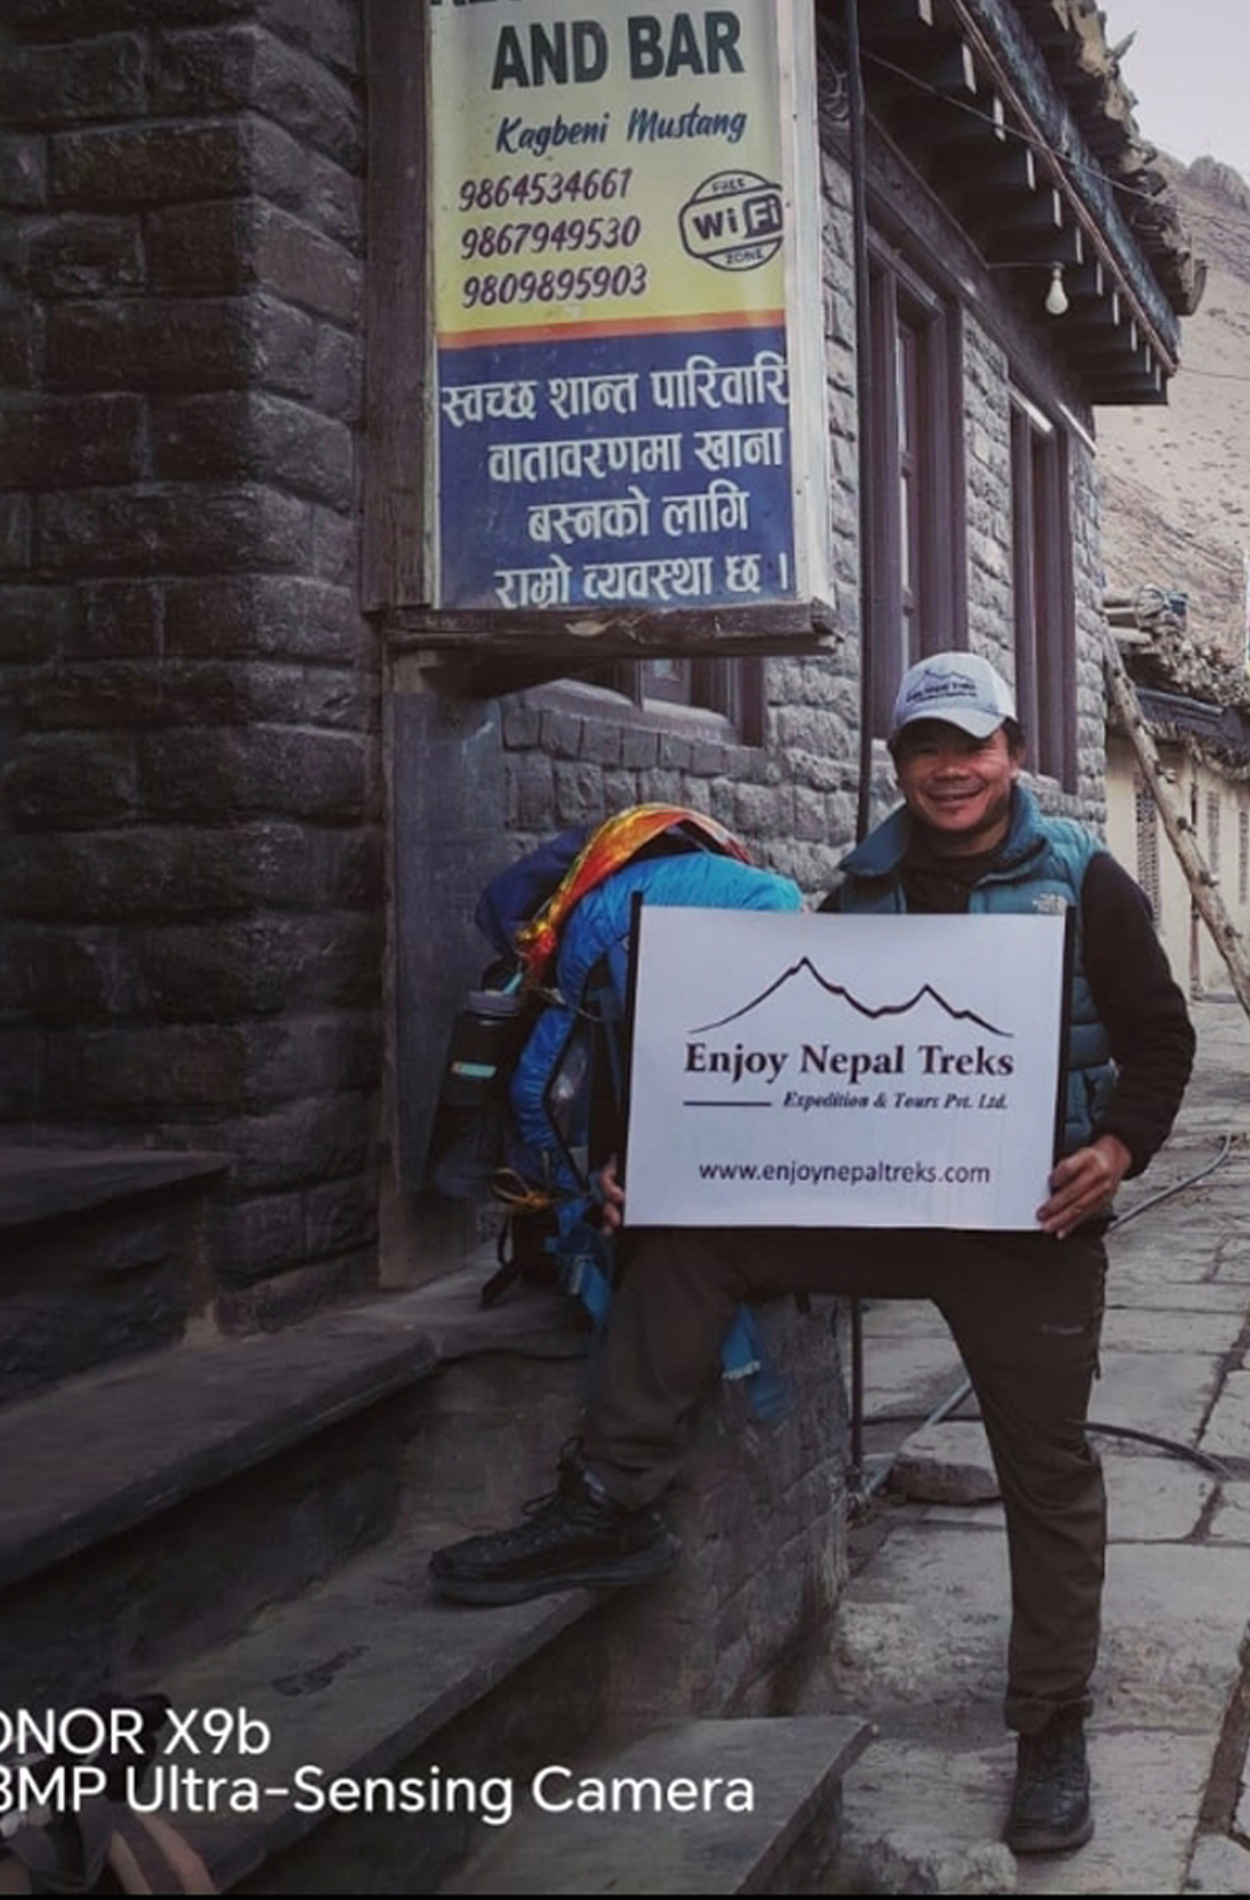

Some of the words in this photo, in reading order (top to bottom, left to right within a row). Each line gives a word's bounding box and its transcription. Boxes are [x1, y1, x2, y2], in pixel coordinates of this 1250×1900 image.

[491, 19, 609, 90] AND
[627, 10, 745, 80] BAR
[496, 113, 609, 156] Kagbeni
[626, 103, 747, 144] Mustang
[458, 168, 633, 212] 9864534661
[460, 215, 641, 259] 9867949530
[462, 263, 647, 308] 9809895903
[442, 380, 538, 428] स्वच्छ
[549, 373, 638, 420] शान्त
[488, 432, 682, 483] वातावरणमा
[693, 427, 784, 471] खाना
[528, 486, 649, 545] बस्नको
[661, 478, 749, 537] लागि
[583, 556, 713, 601] व्यवस्था
[725, 553, 762, 593] छ
[684, 1042, 788, 1084] Enjoy
[800, 1044, 904, 1084] Nepal
[917, 1045, 1014, 1076] Treks
[782, 1091, 869, 1112] Expedition
[873, 1093, 888, 1108] &
[893, 1092, 939, 1109] Tours
[943, 1093, 974, 1109] Pvt.
[978, 1094, 1008, 1109] Ltd.
[699, 1160, 991, 1184] www.enjoynepaltreks.com
